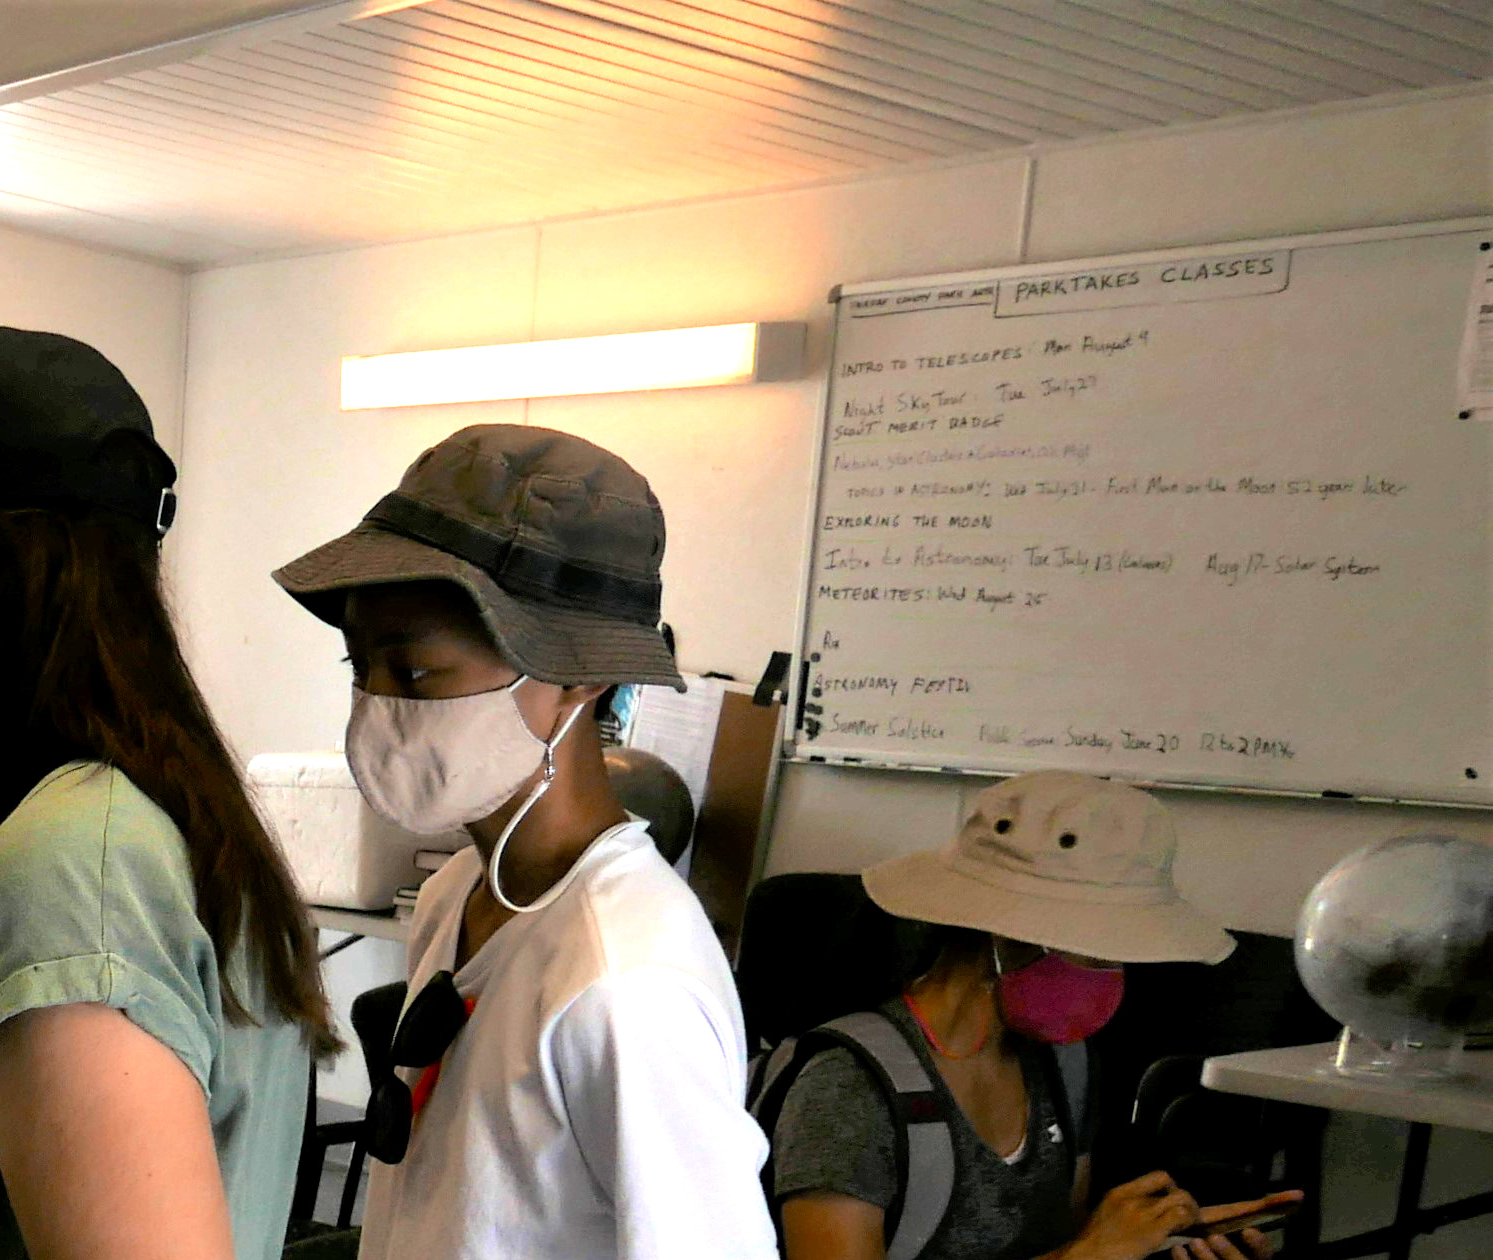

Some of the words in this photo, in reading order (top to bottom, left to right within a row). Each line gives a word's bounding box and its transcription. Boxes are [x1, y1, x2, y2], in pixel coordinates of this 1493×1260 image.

[1016, 271, 1140, 303] PARKTAKES
[1160, 258, 1273, 284] CLASSES
[841, 361, 884, 378] INTRO
[891, 359, 908, 371] TO
[843, 400, 885, 418] Night
[833, 419, 881, 441] SCOUT
[888, 418, 938, 434] MERIT
[949, 413, 1006, 430] BADGE
[823, 514, 901, 531] EXPLORING
[913, 515, 939, 529] THE
[949, 514, 994, 530] MOON
[824, 548, 871, 570] Intro
[884, 550, 902, 567] to
[1274, 554, 1316, 575] Solar
[1322, 556, 1382, 581] System
[937, 585, 967, 601] Wed
[815, 673, 899, 696] ASTRONOMY
[829, 712, 879, 735] Summer
[1065, 725, 1114, 752] Sunday
[1120, 728, 1152, 750] June
[1157, 733, 1180, 754] 20
[1236, 736, 1249, 755] 2
